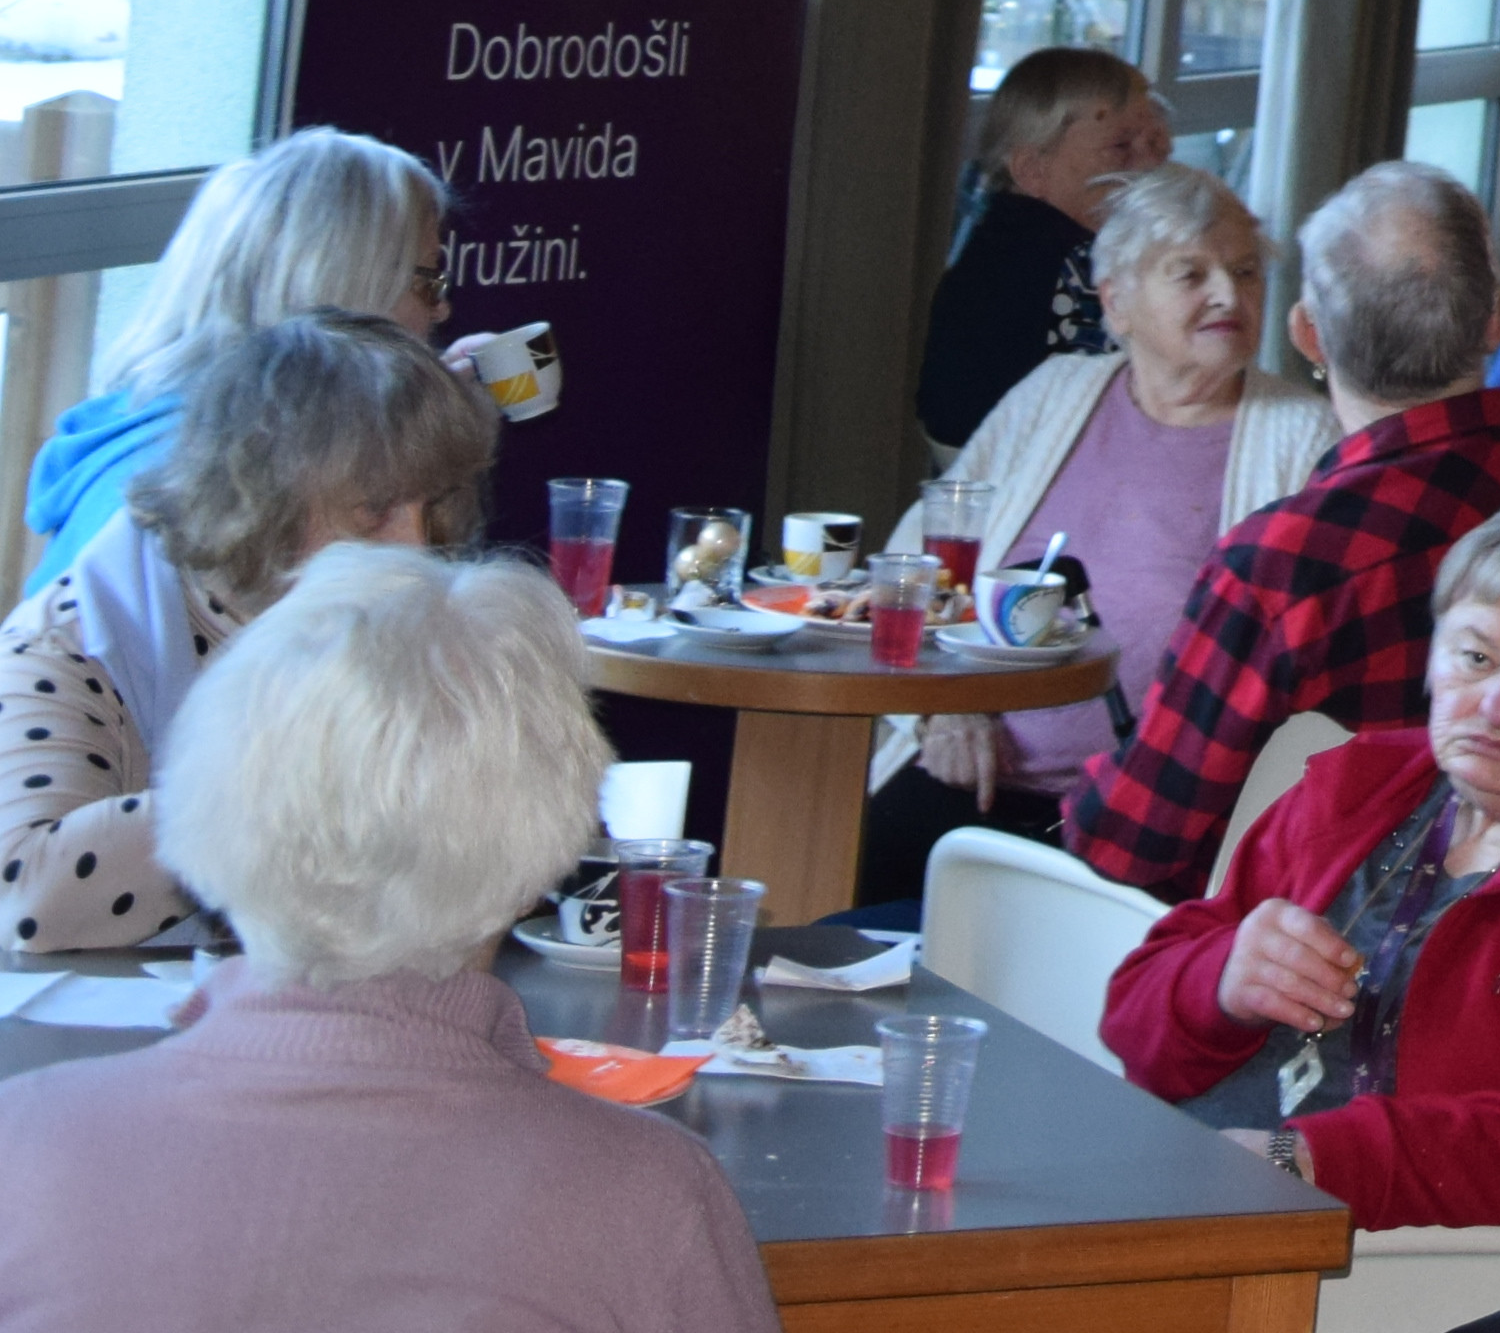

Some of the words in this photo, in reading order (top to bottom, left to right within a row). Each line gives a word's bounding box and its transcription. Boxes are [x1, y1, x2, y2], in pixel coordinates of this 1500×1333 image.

[446, 18, 691, 81] Dobrodošli
[436, 139, 464, 183] v
[478, 122, 638, 183] Mavida
